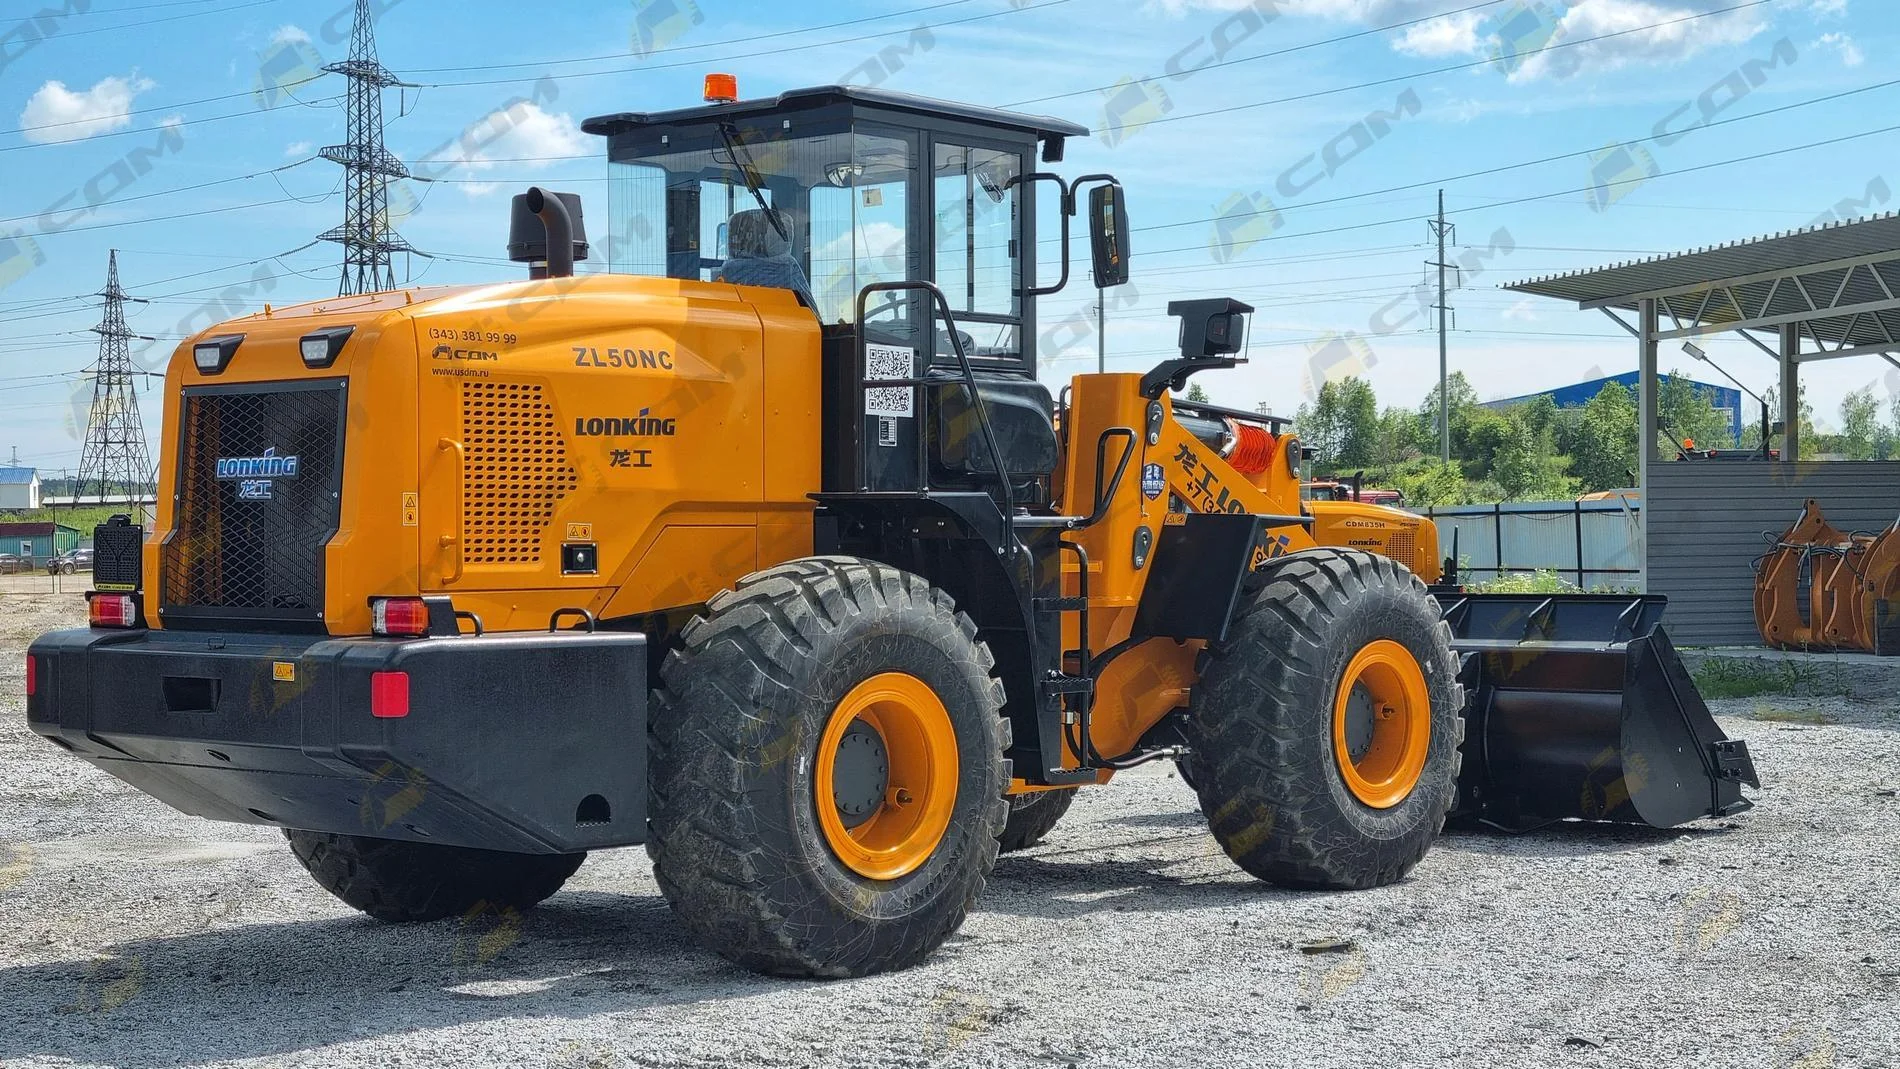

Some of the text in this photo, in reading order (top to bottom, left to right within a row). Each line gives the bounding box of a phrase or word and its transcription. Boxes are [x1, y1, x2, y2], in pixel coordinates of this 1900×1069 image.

[429, 328, 517, 344] (343) 381 99 99
[572, 347, 673, 370] ZL50NC
[432, 368, 489, 377] www.usdm.ru
[609, 449, 652, 468] 龙工
[239, 480, 272, 500] 龙工
